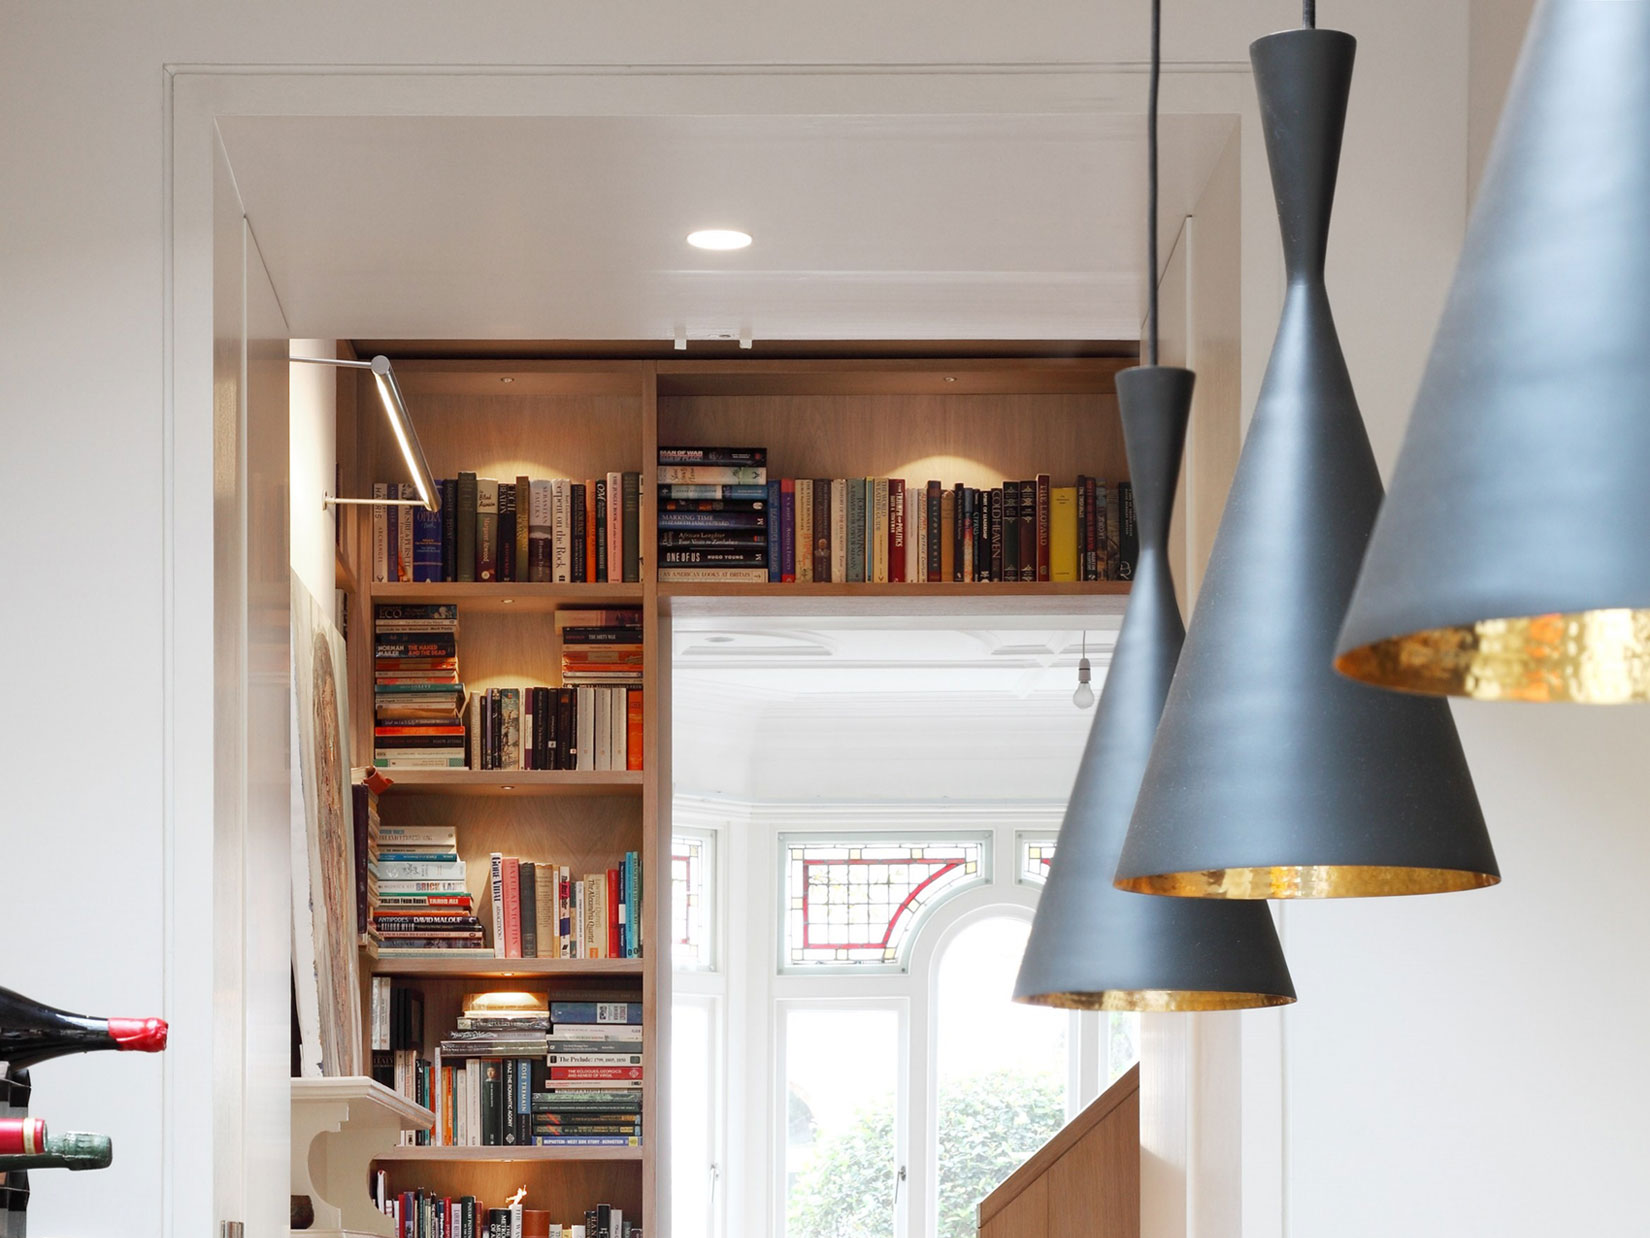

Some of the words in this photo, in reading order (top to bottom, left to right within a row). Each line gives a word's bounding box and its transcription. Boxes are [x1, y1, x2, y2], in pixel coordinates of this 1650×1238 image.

[554, 482, 565, 514] Serpent
[992, 490, 1000, 518] COLD
[1040, 484, 1048, 503] THE
[857, 497, 865, 522] JOHN
[482, 518, 490, 540] Margaret
[556, 517, 563, 527] on
[1040, 504, 1048, 546] LEOPARD
[556, 530, 566, 544] the
[857, 526, 865, 556] IRVING
[992, 518, 1000, 558] HEAVEN
[482, 542, 490, 562] Atwood
[556, 546, 566, 569] Rock
[666, 552, 680, 562] ONE
[681, 552, 690, 562] OF
[691, 552, 701, 562] US
[379, 610, 402, 618] ECO
[492, 857, 501, 879] GORE
[416, 882, 440, 891] BRICK
[492, 880, 502, 901] VIDAL
[490, 1224, 495, 1232] OF
